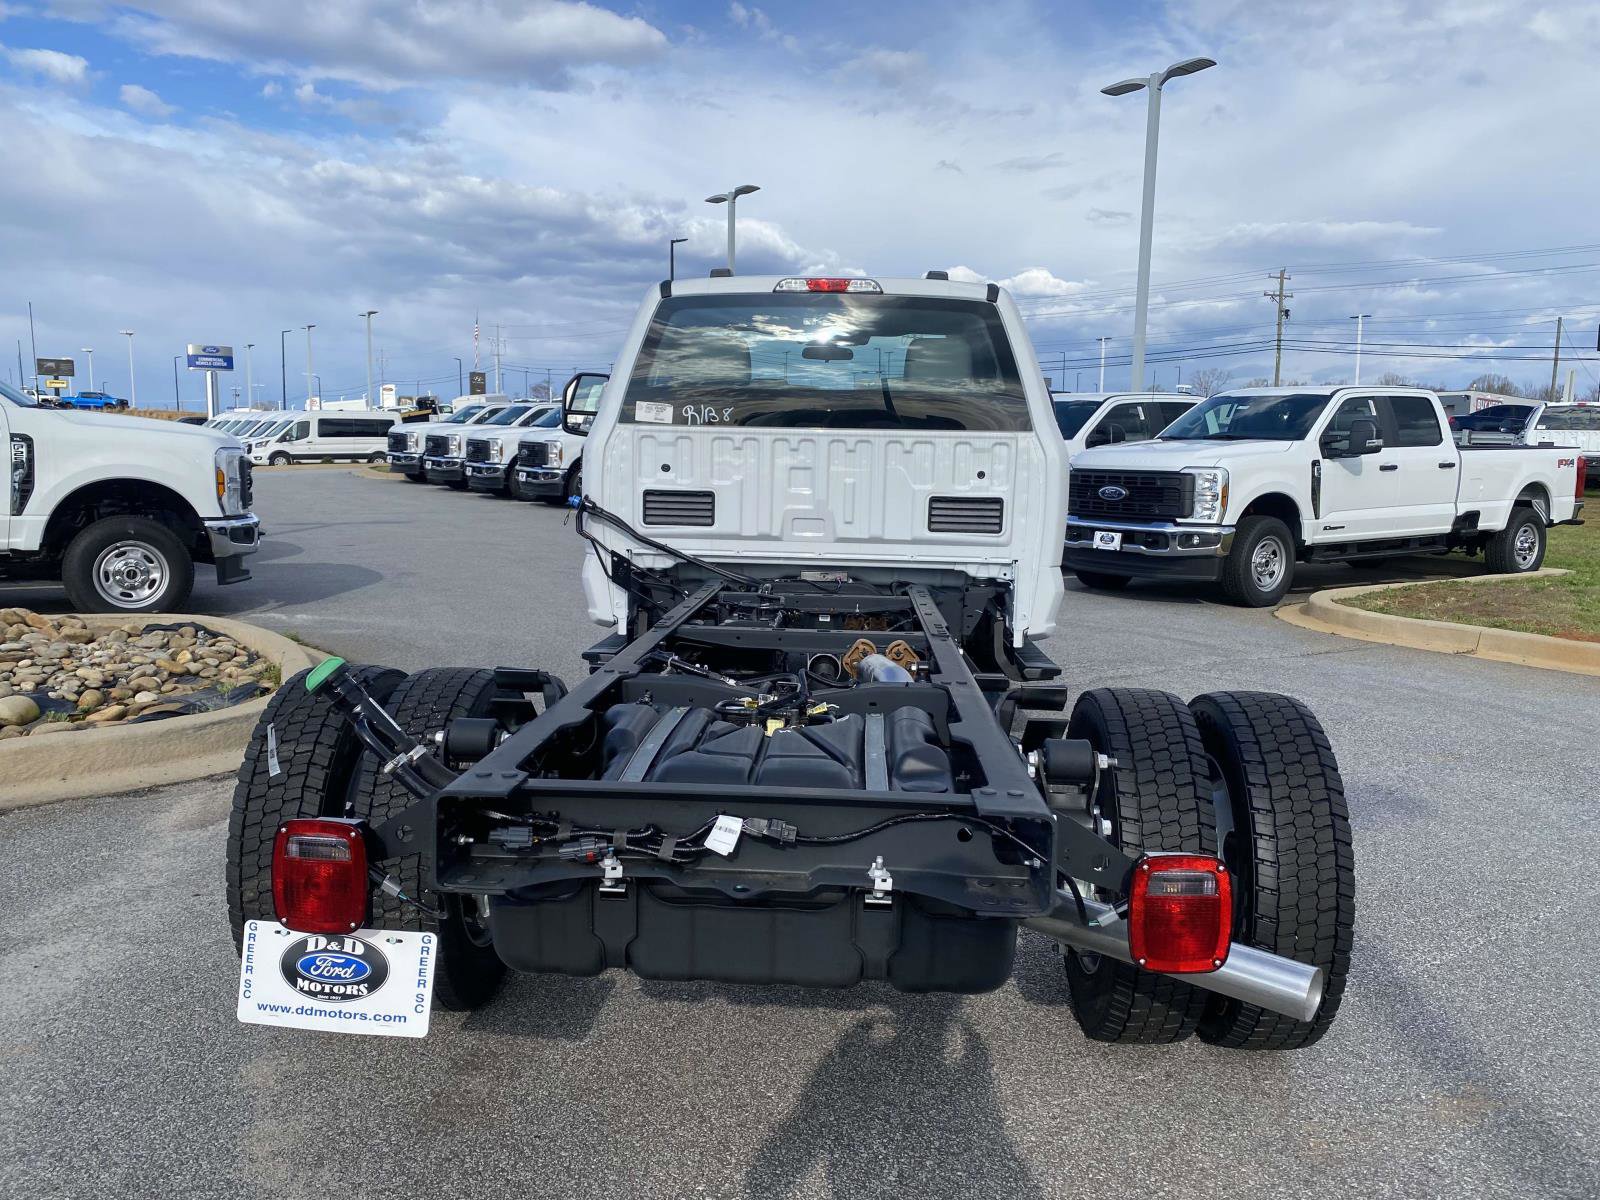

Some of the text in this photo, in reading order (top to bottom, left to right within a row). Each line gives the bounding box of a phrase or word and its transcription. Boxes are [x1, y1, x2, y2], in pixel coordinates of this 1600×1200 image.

[310, 956, 354, 979] Ford
[296, 978, 368, 996] MOTORS
[257, 1002, 407, 1023] www.ddmotors.com
